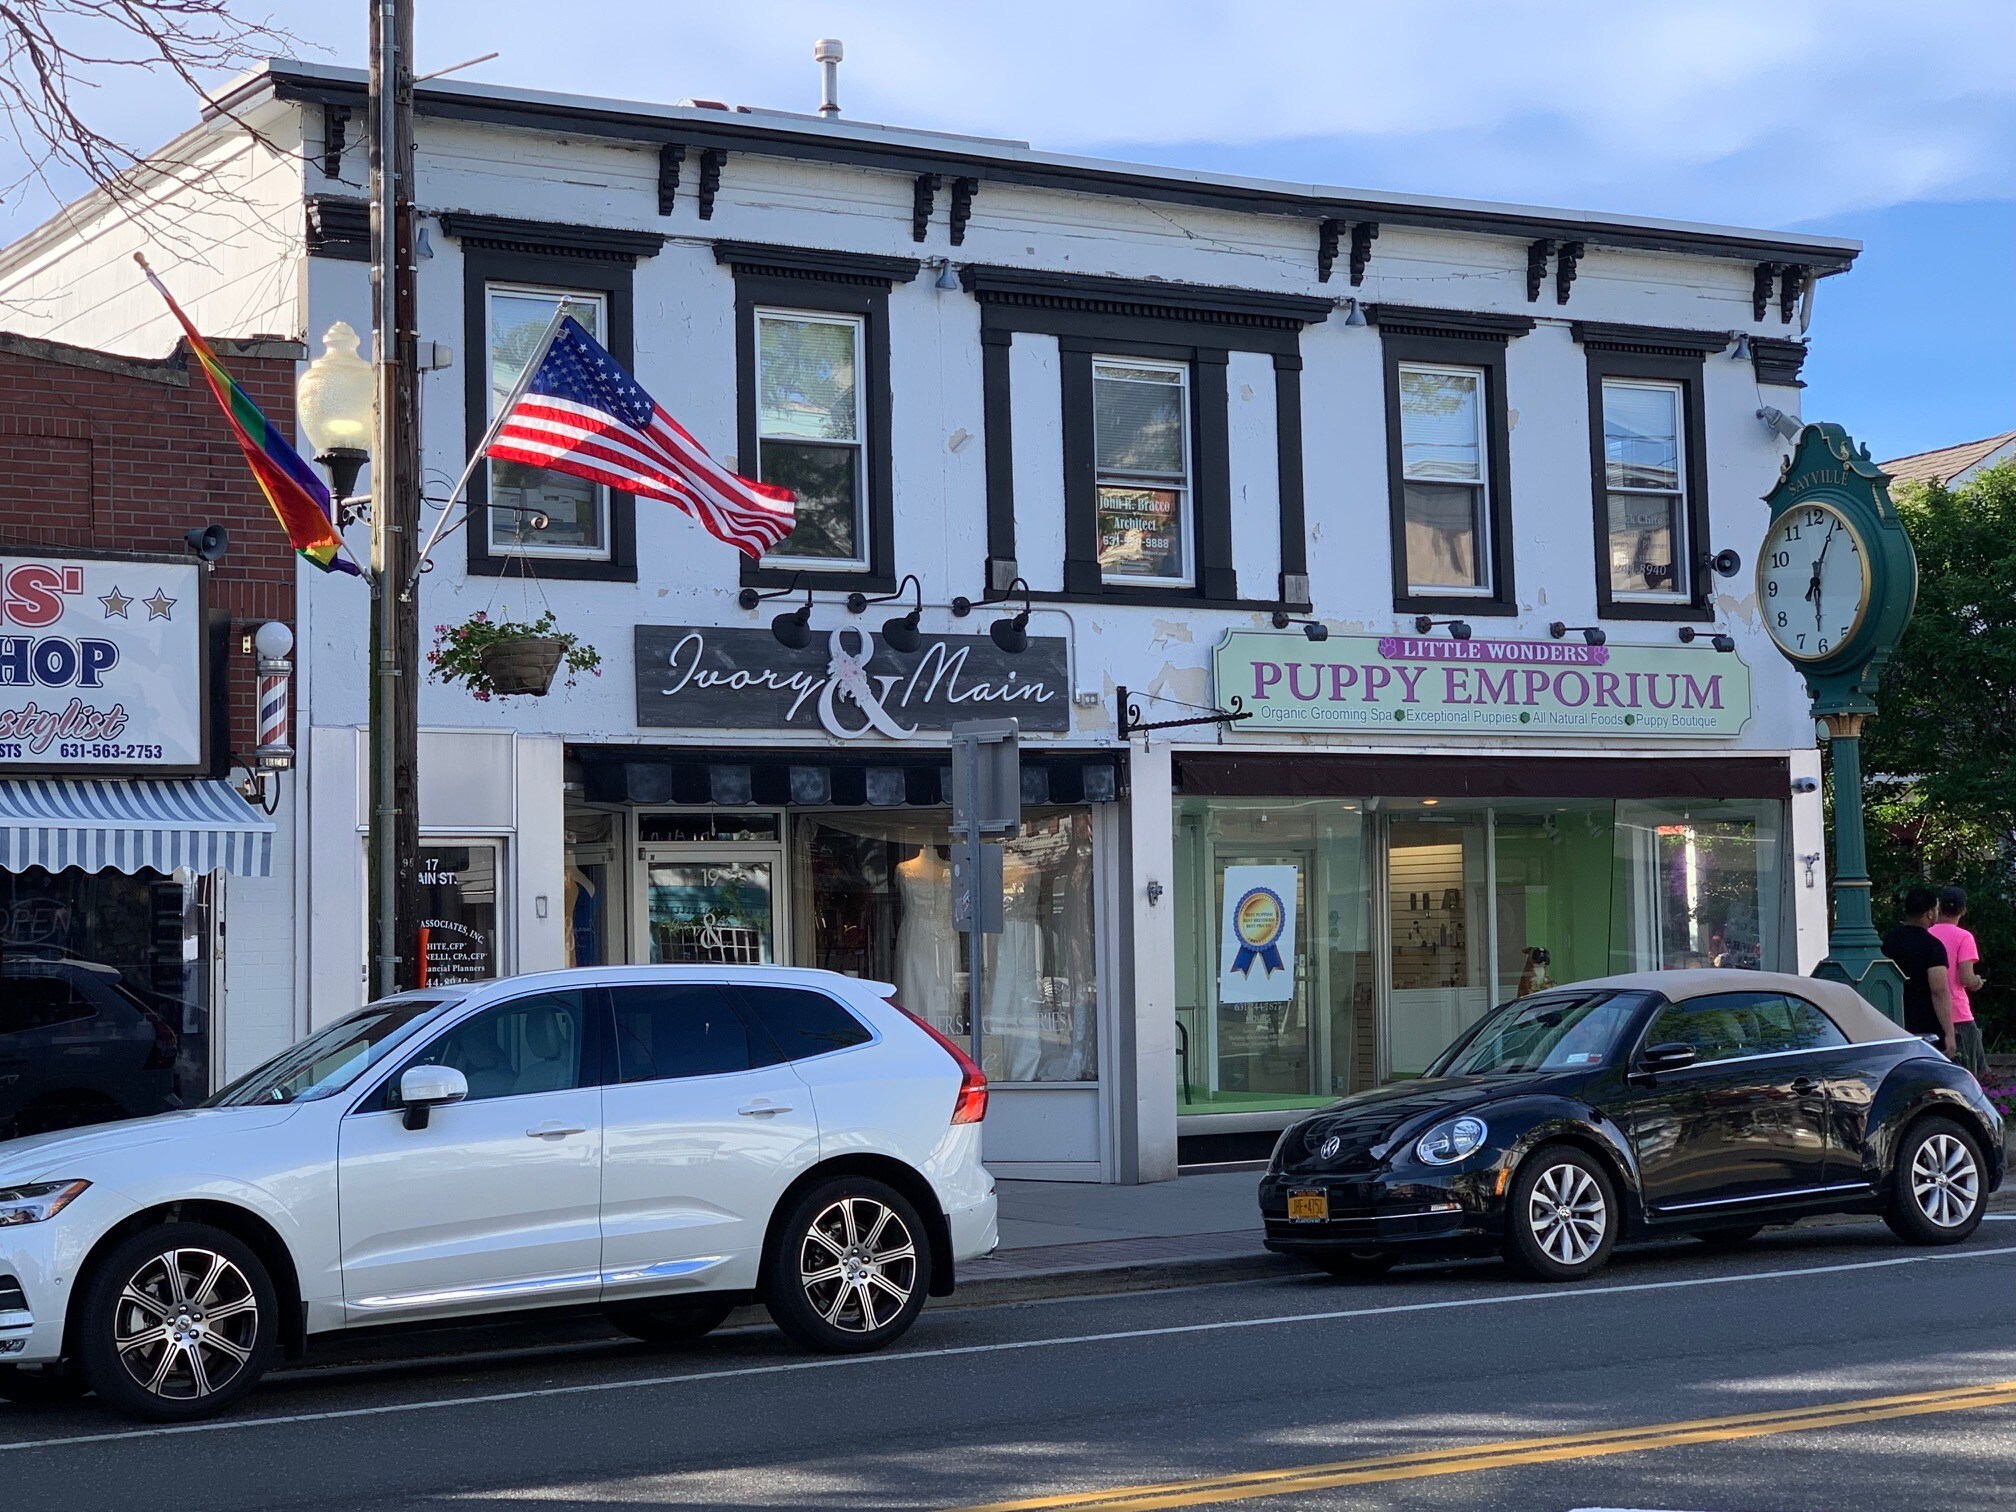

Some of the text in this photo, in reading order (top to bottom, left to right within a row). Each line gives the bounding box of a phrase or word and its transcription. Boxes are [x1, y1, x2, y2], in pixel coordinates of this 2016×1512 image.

[1789, 470, 1849, 495] SAYVILLE
[1099, 496, 1171, 512] John R. Bracco
[1114, 517, 1156, 531] Architect
[1805, 509, 1824, 527] 12
[1784, 525, 1802, 541] 11
[1103, 535, 1169, 548] 631--9888
[1772, 551, 1790, 569] 10
[0, 563, 83, 627] S'
[1768, 581, 1778, 597] 9
[1777, 611, 1788, 627] 8
[1796, 633, 1806, 649] 7
[1818, 638, 1829, 654] 6
[1403, 641, 1589, 662] LITTLE WONDERS
[662, 625, 1056, 740] Ivory & Main
[1250, 661, 1725, 710] PUPPY EMPORIUM
[1261, 706, 1717, 728] Organic Grooming Spa Exceptional Puppies All Natural Foods Puppy Boutique
[60, 743, 163, 759] 631-563-2753
[440, 872, 457, 885] ST.
[701, 869, 720, 887] 19
[420, 919, 469, 936] ASSOCIATES,
[452, 964, 486, 972] Planners
